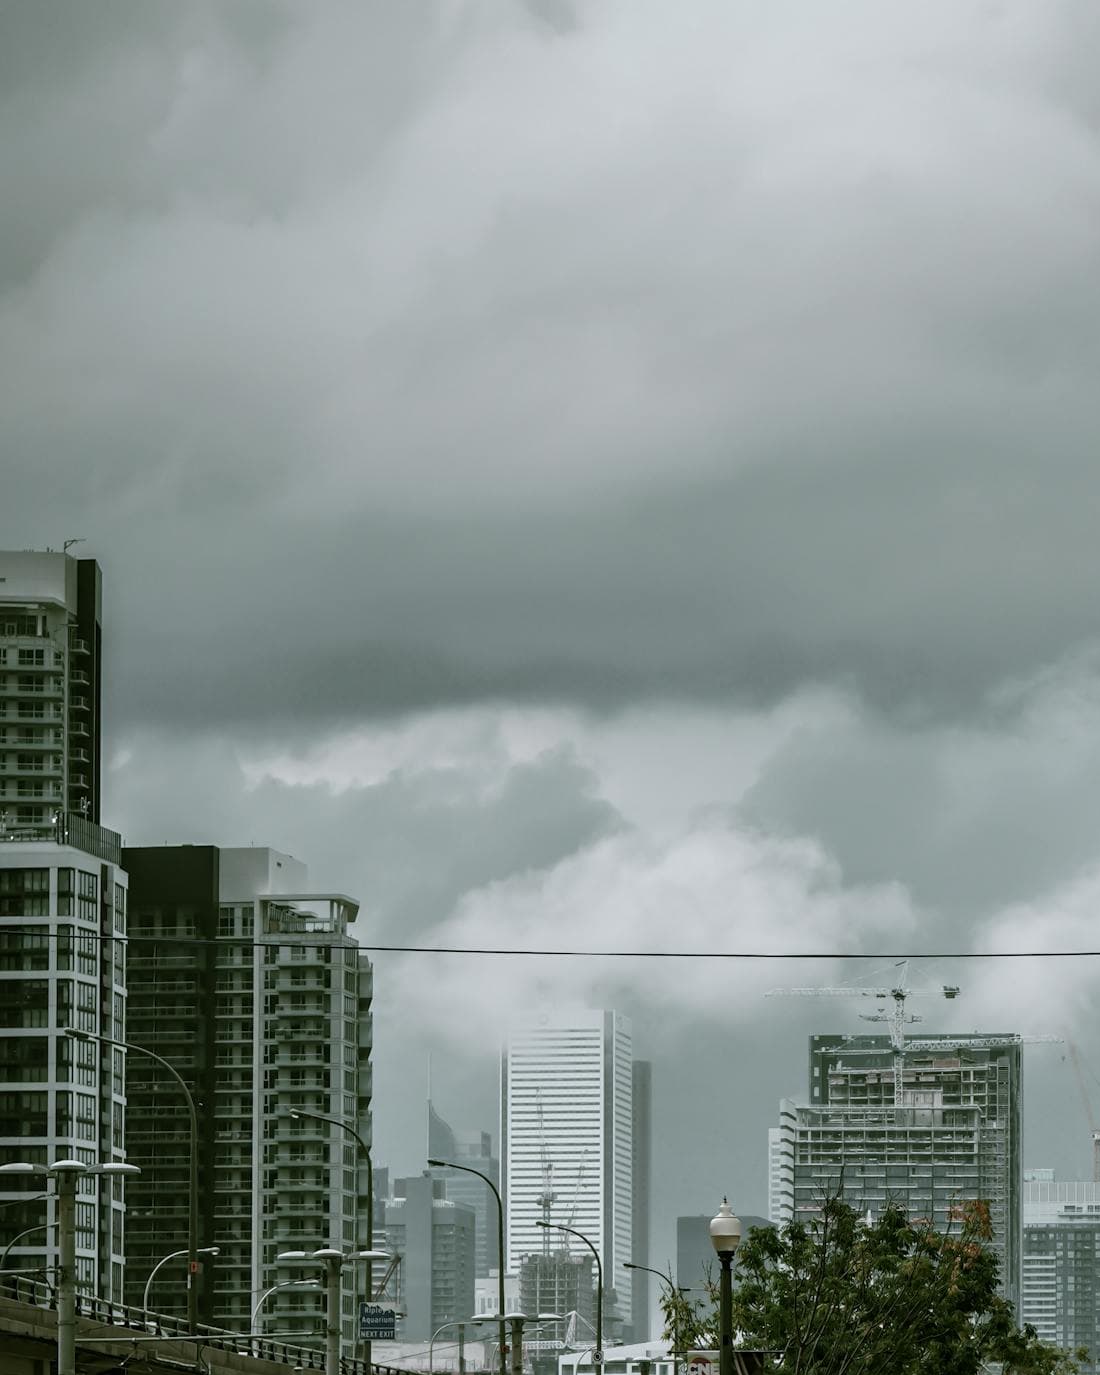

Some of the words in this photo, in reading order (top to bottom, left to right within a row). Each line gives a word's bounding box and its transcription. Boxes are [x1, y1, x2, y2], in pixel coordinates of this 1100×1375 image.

[361, 1316, 394, 1325] Aquarium
[360, 1330, 378, 1338] NEXT
[379, 1330, 394, 1338] EXIT
